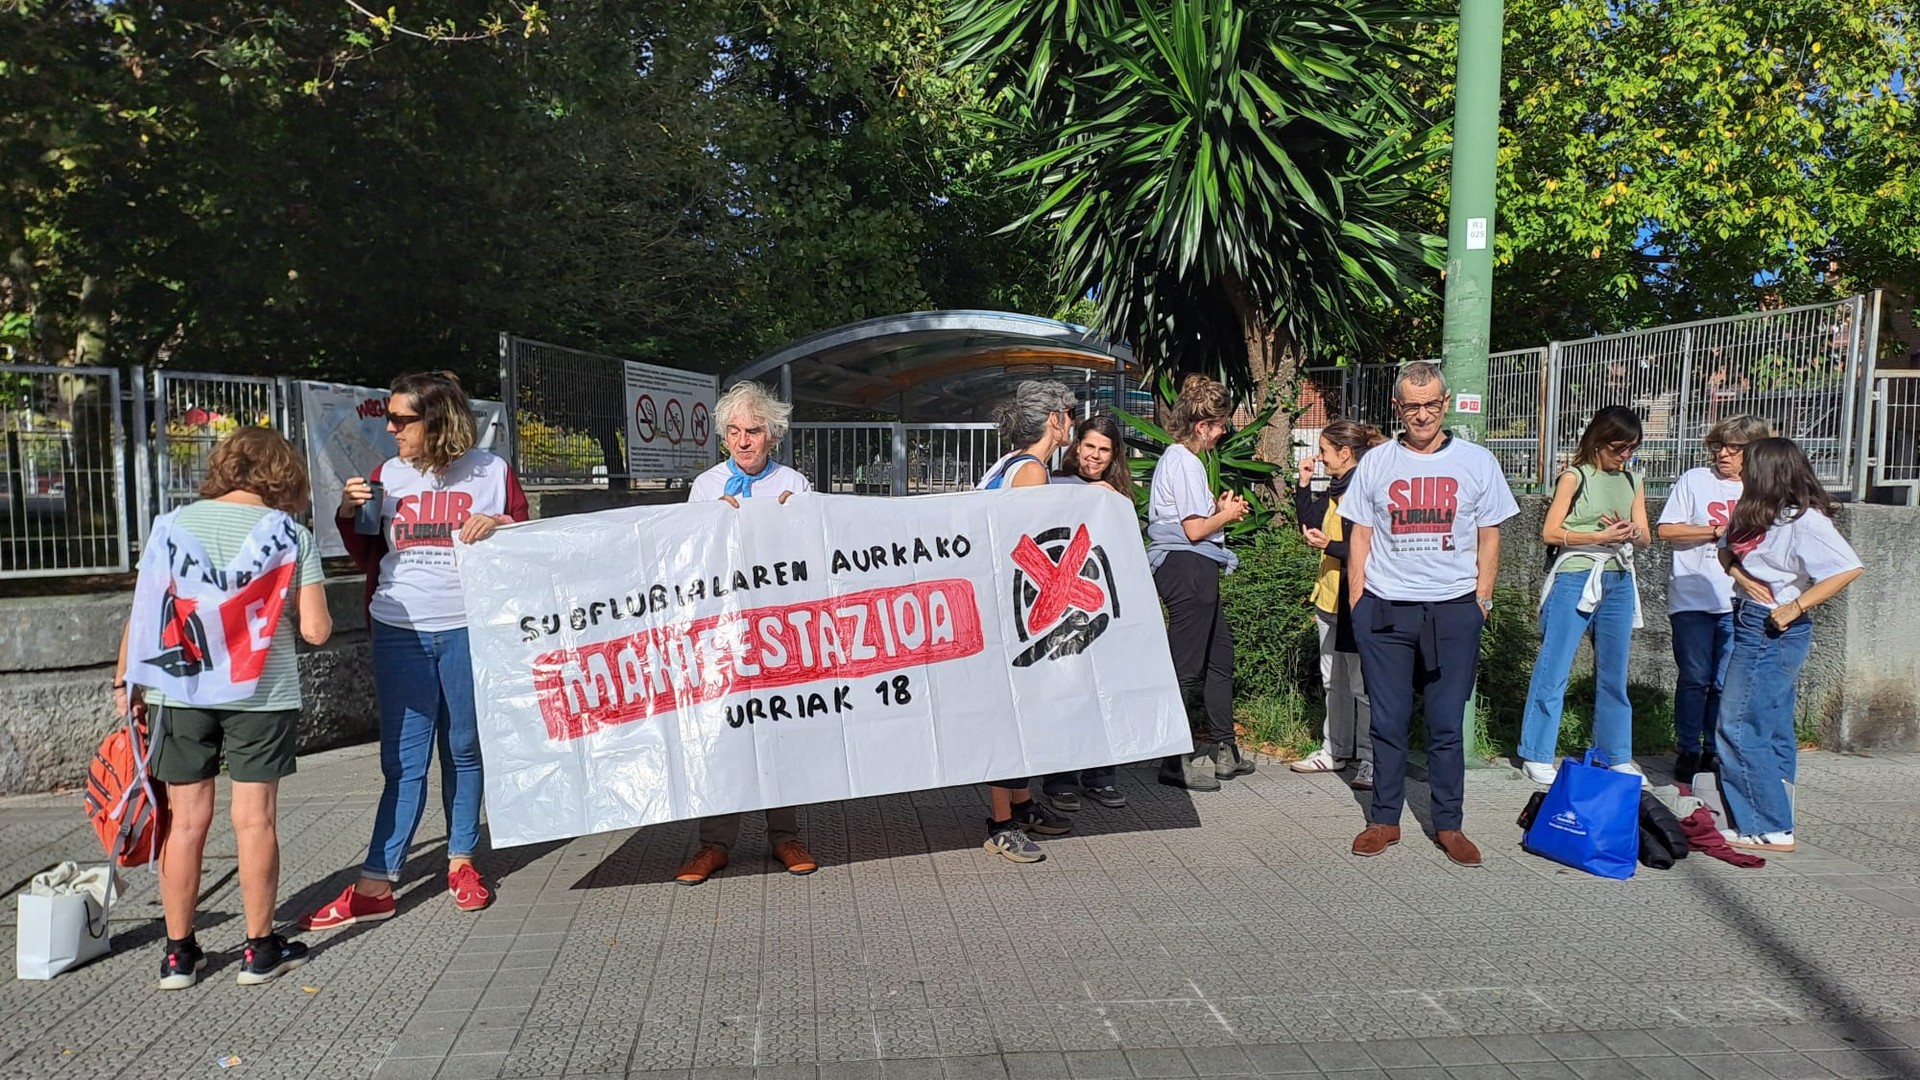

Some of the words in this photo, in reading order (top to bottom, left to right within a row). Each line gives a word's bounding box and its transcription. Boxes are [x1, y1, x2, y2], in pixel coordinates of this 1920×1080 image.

[392, 491, 473, 526] SUB
[1387, 477, 1458, 511] SUB
[395, 522, 465, 540] FLUBIAL
[1391, 509, 1453, 525] FLUBIALA
[520, 560, 808, 643] SUBFLUBIALAREN
[831, 534, 972, 575] AURKAKO
[560, 589, 955, 715] MANIFESTAZIOA
[725, 685, 854, 728] URRIAK
[875, 674, 912, 705] 18
